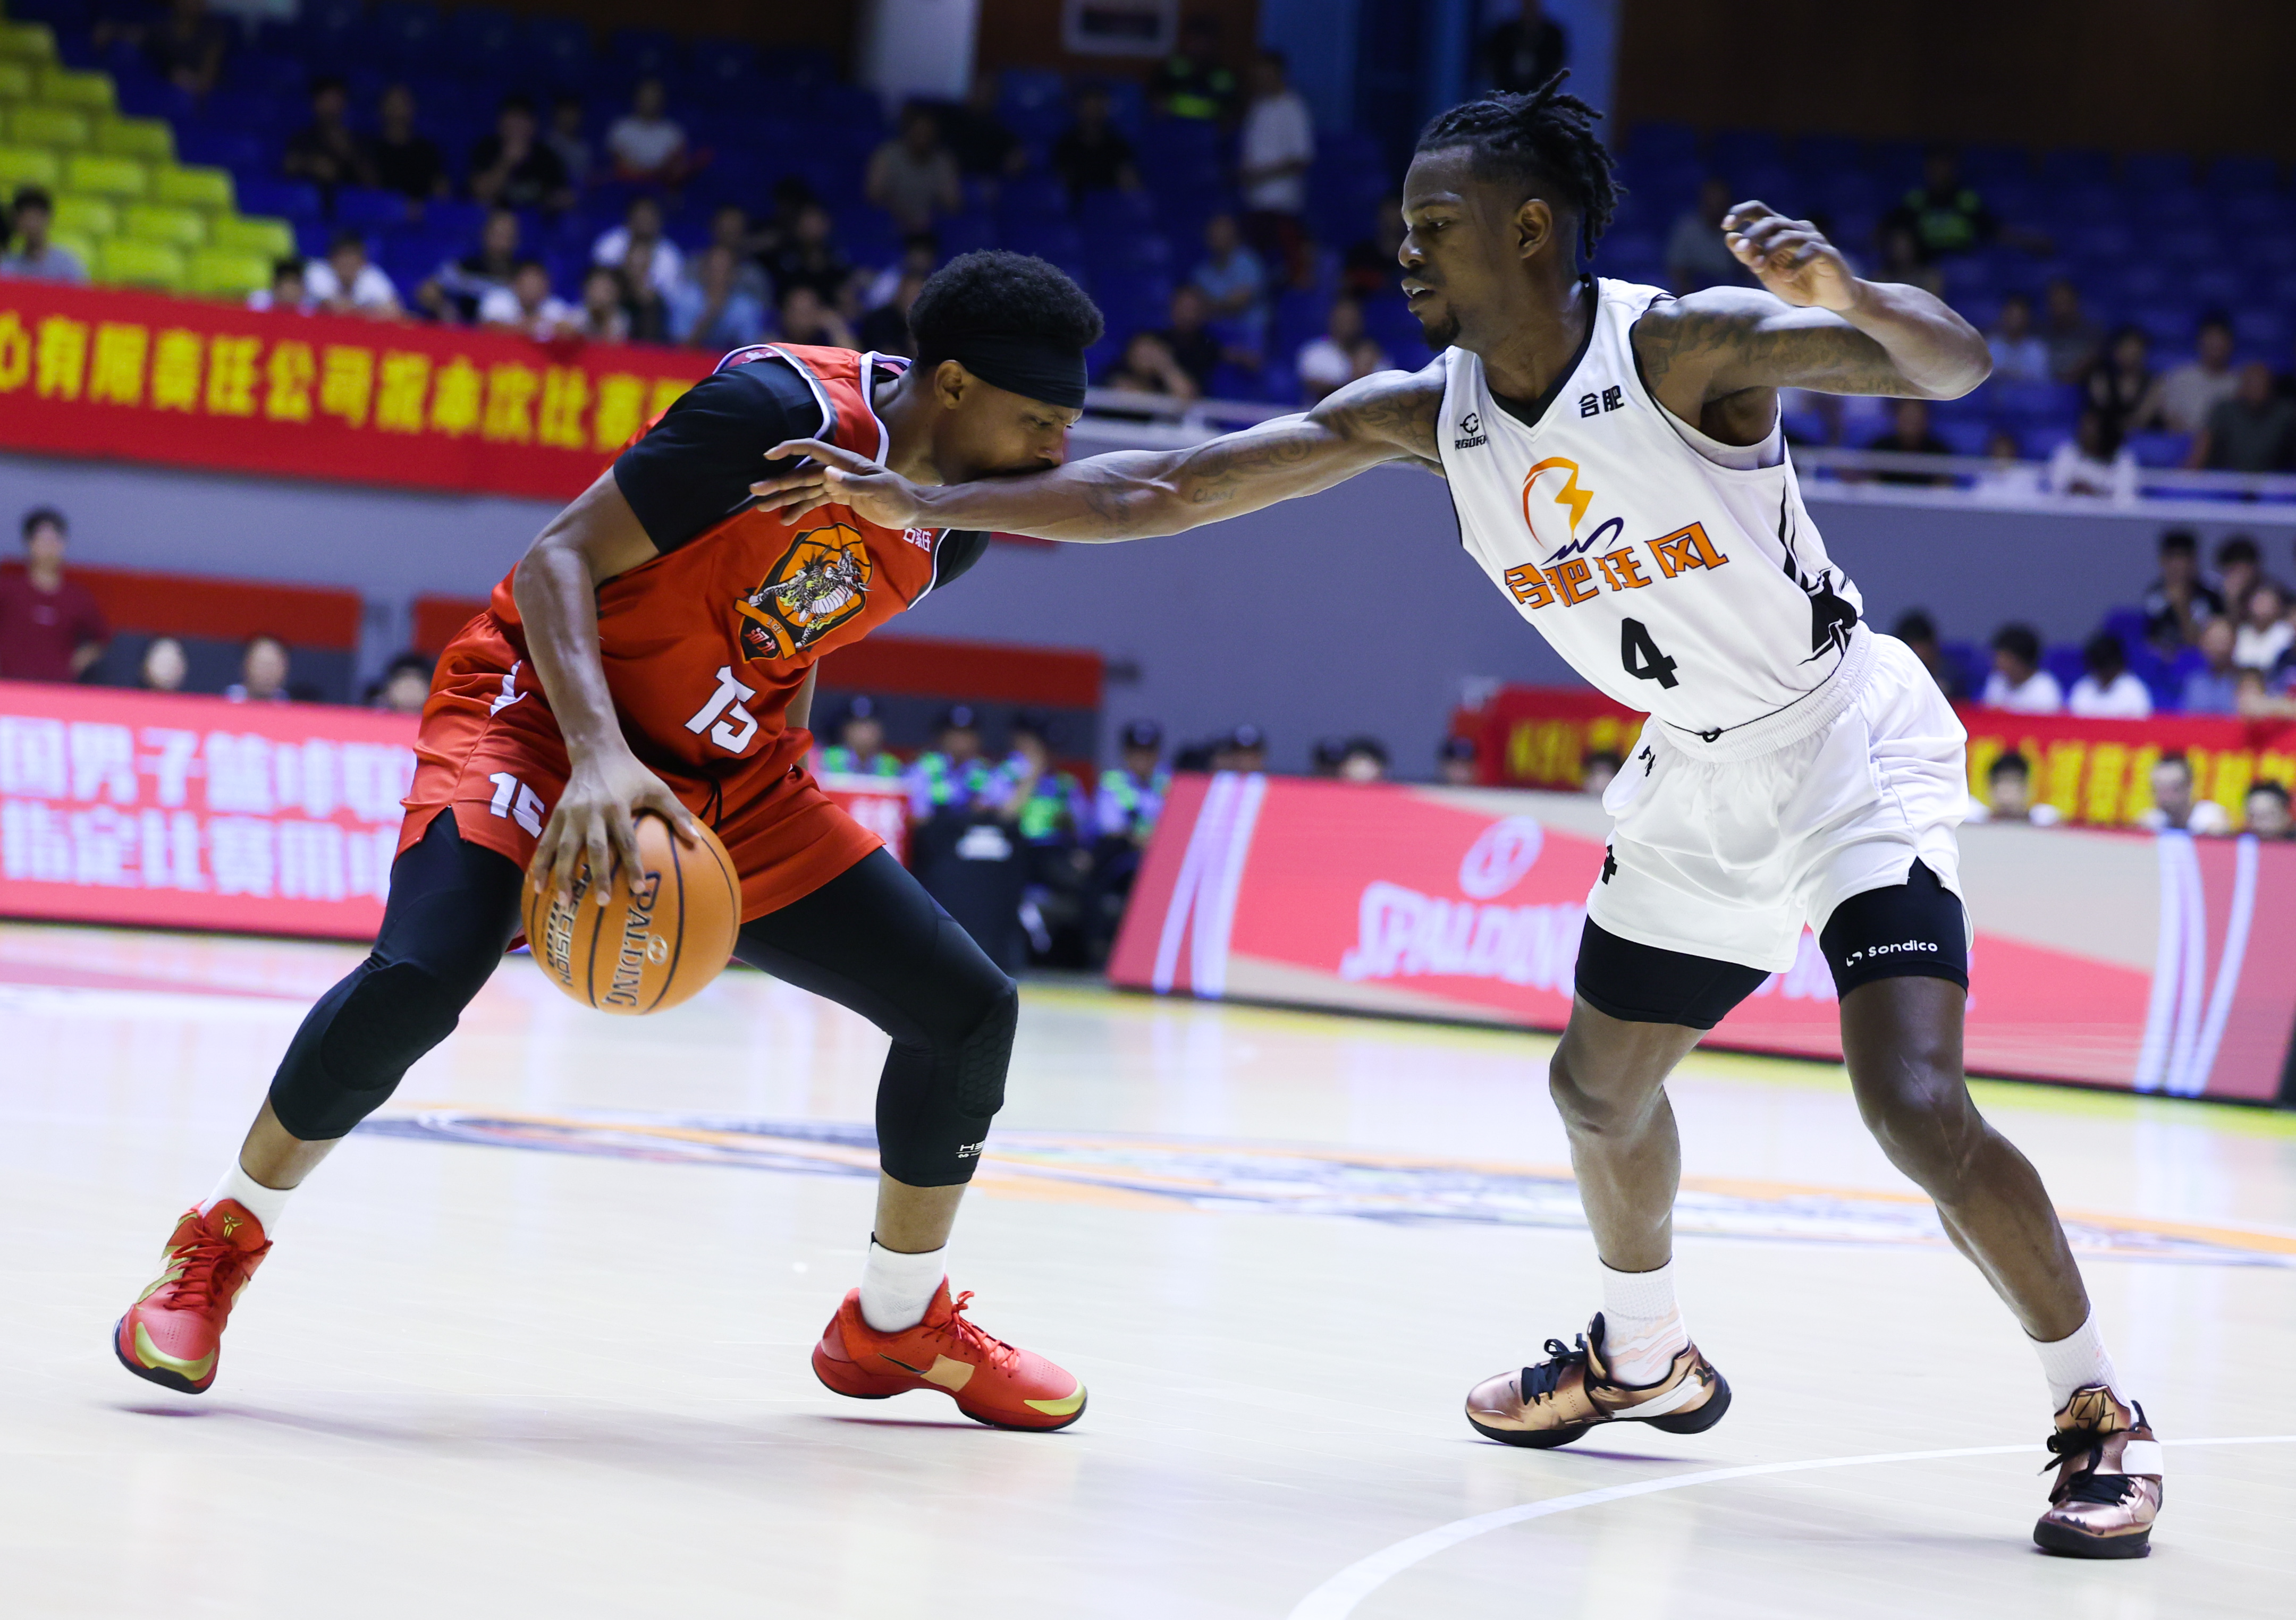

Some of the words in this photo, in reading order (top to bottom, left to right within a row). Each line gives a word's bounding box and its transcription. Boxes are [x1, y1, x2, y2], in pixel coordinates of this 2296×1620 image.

[1578, 385, 1625, 418] 合肥
[1505, 521, 1729, 609] 合肥狂风
[1622, 617, 1679, 689] 4
[685, 665, 758, 753] 15
[1868, 939, 1938, 957] sondico
